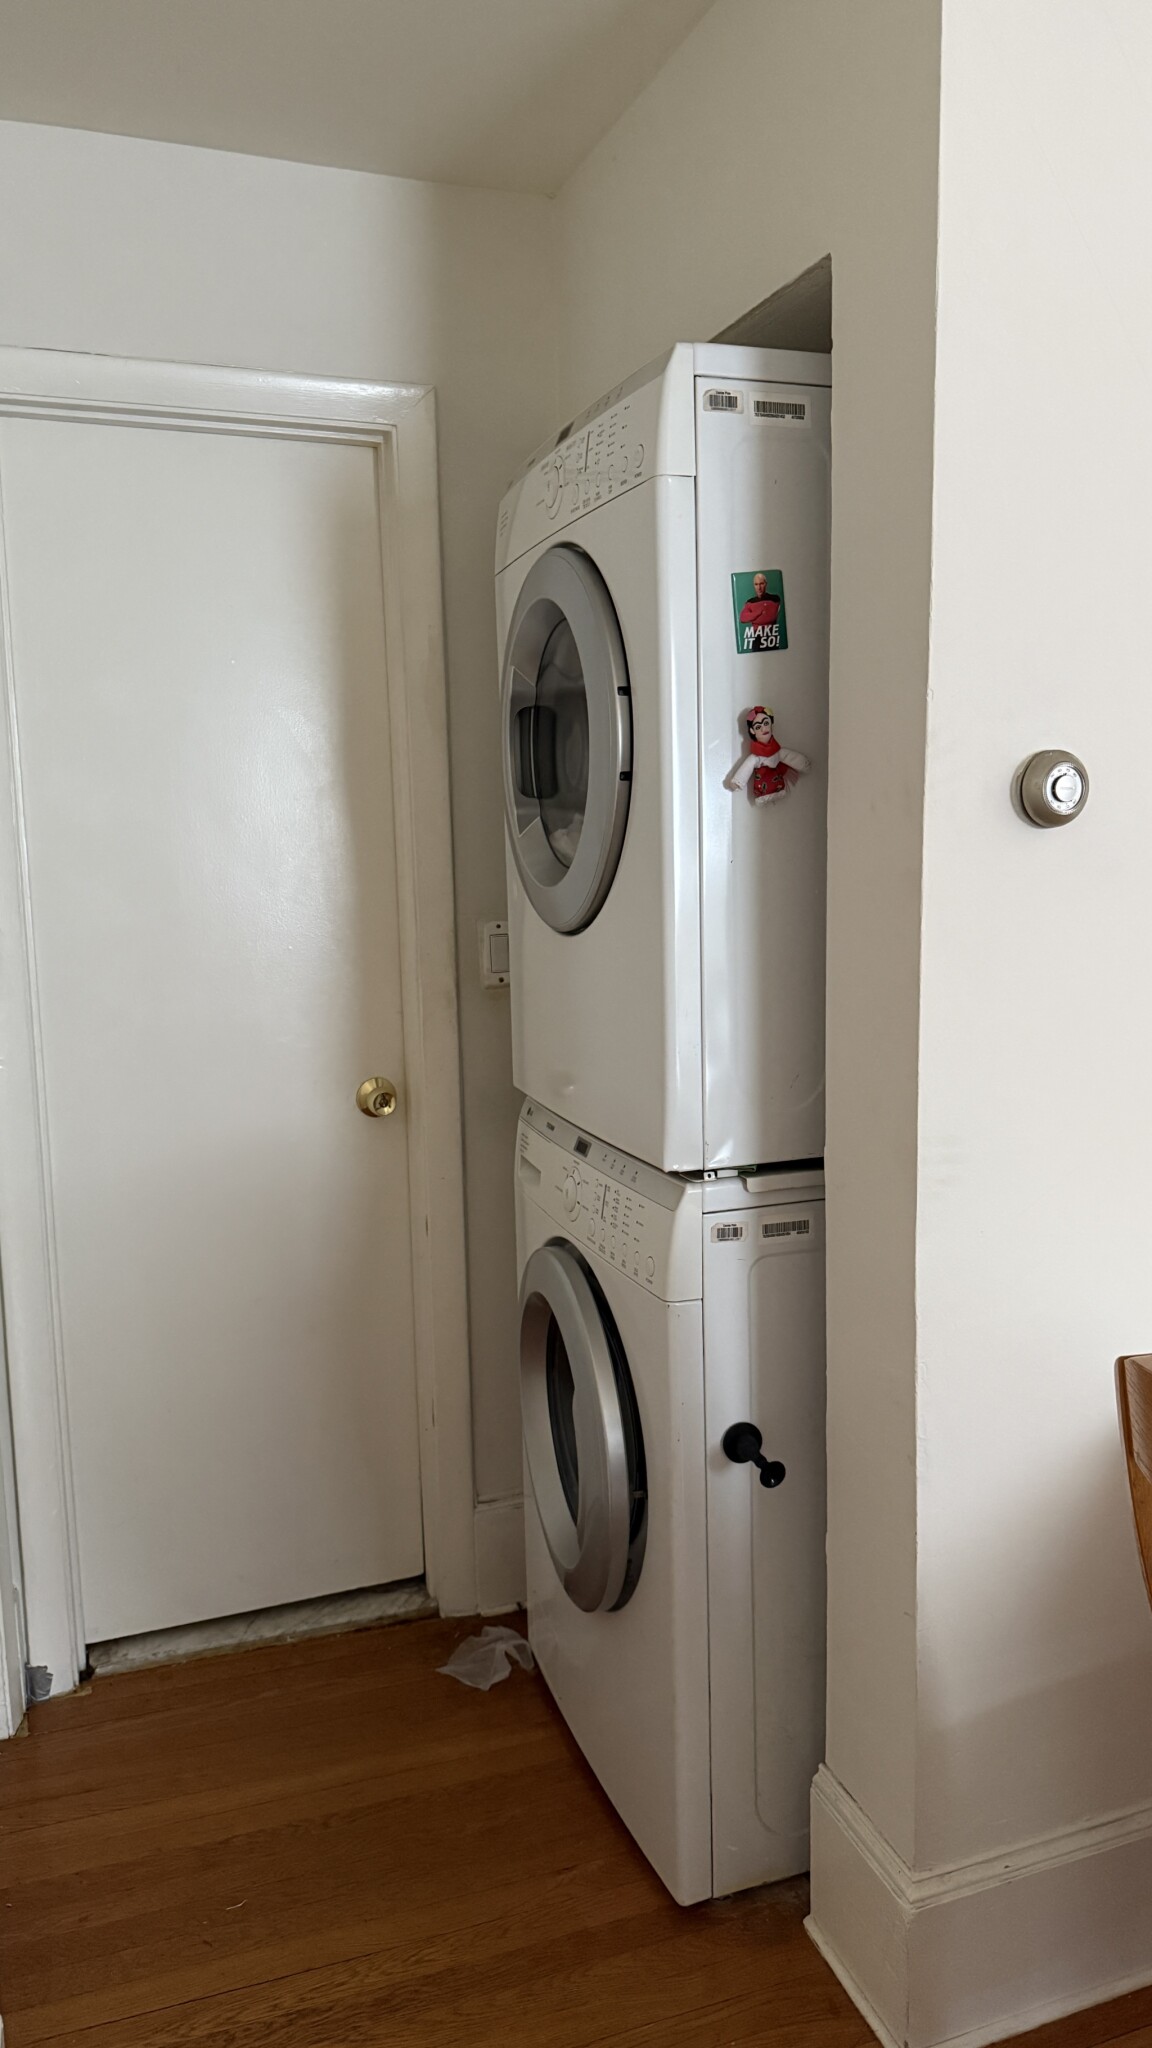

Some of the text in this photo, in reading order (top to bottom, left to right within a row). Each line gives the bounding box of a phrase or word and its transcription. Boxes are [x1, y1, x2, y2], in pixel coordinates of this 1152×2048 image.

[743, 624, 780, 638] MAKE
[743, 636, 780, 650] IT SO!
